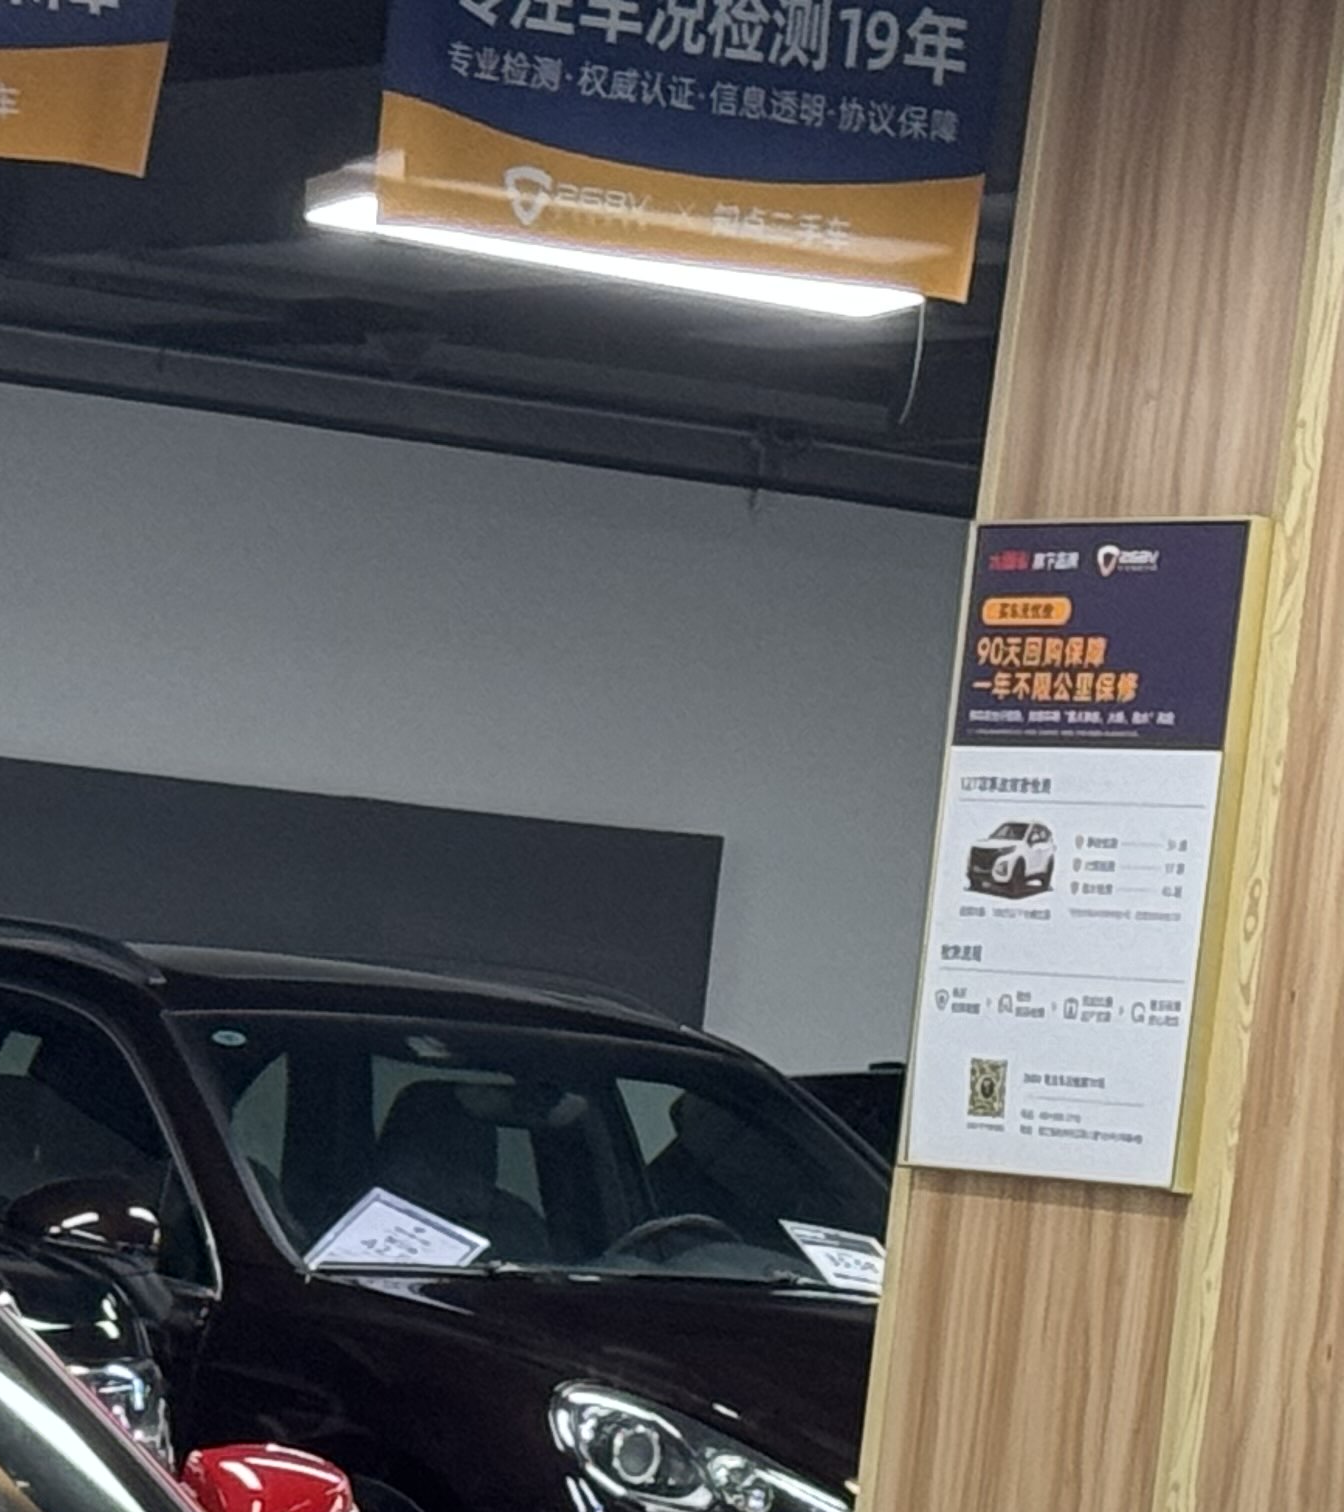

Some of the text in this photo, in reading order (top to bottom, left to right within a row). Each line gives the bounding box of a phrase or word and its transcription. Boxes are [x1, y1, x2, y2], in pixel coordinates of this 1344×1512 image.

[978, 636, 1107, 667] 90天回购保障
[972, 672, 1139, 702] 一年不限公里保修
